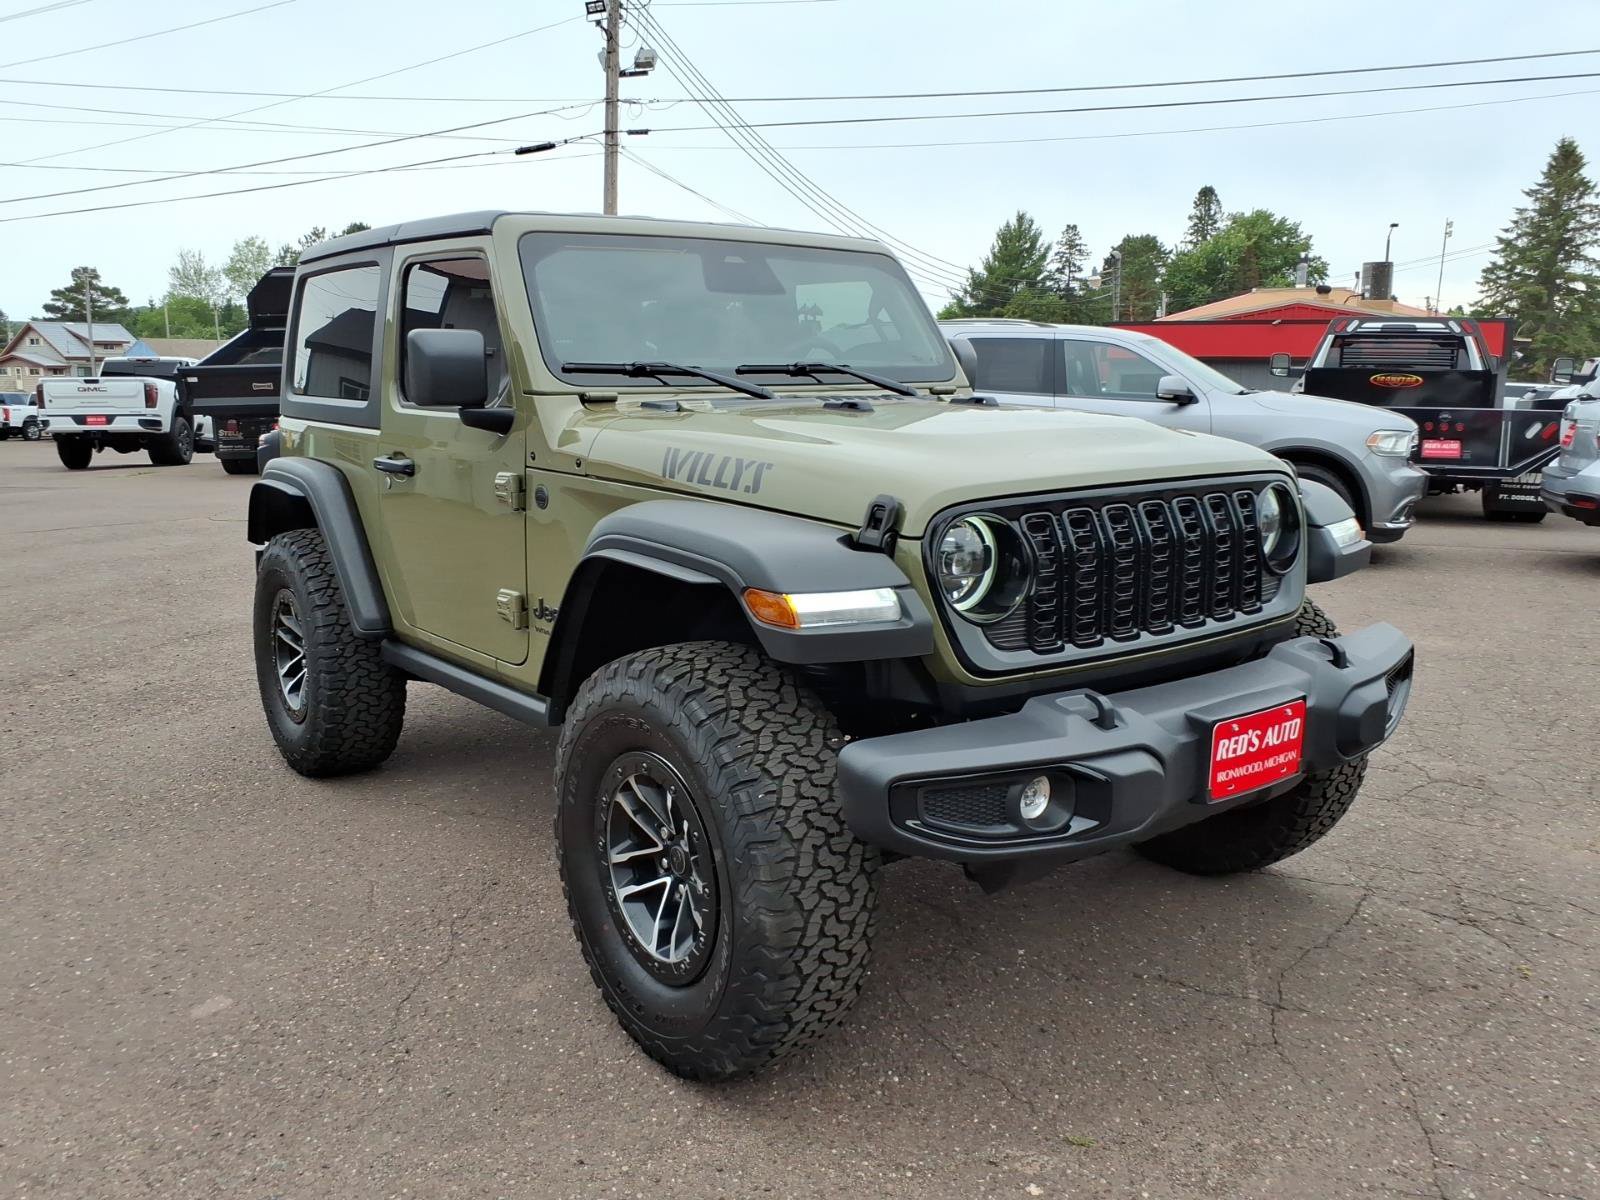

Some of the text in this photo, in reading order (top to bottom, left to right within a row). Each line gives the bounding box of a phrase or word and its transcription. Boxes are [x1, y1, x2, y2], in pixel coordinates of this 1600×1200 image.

[661, 446, 774, 495] WILLYS
[532, 597, 558, 624] Jee
[1215, 718, 1302, 762] RED'S AUTO
[1216, 749, 1297, 783] IRONWOOD, MICHIGAN
